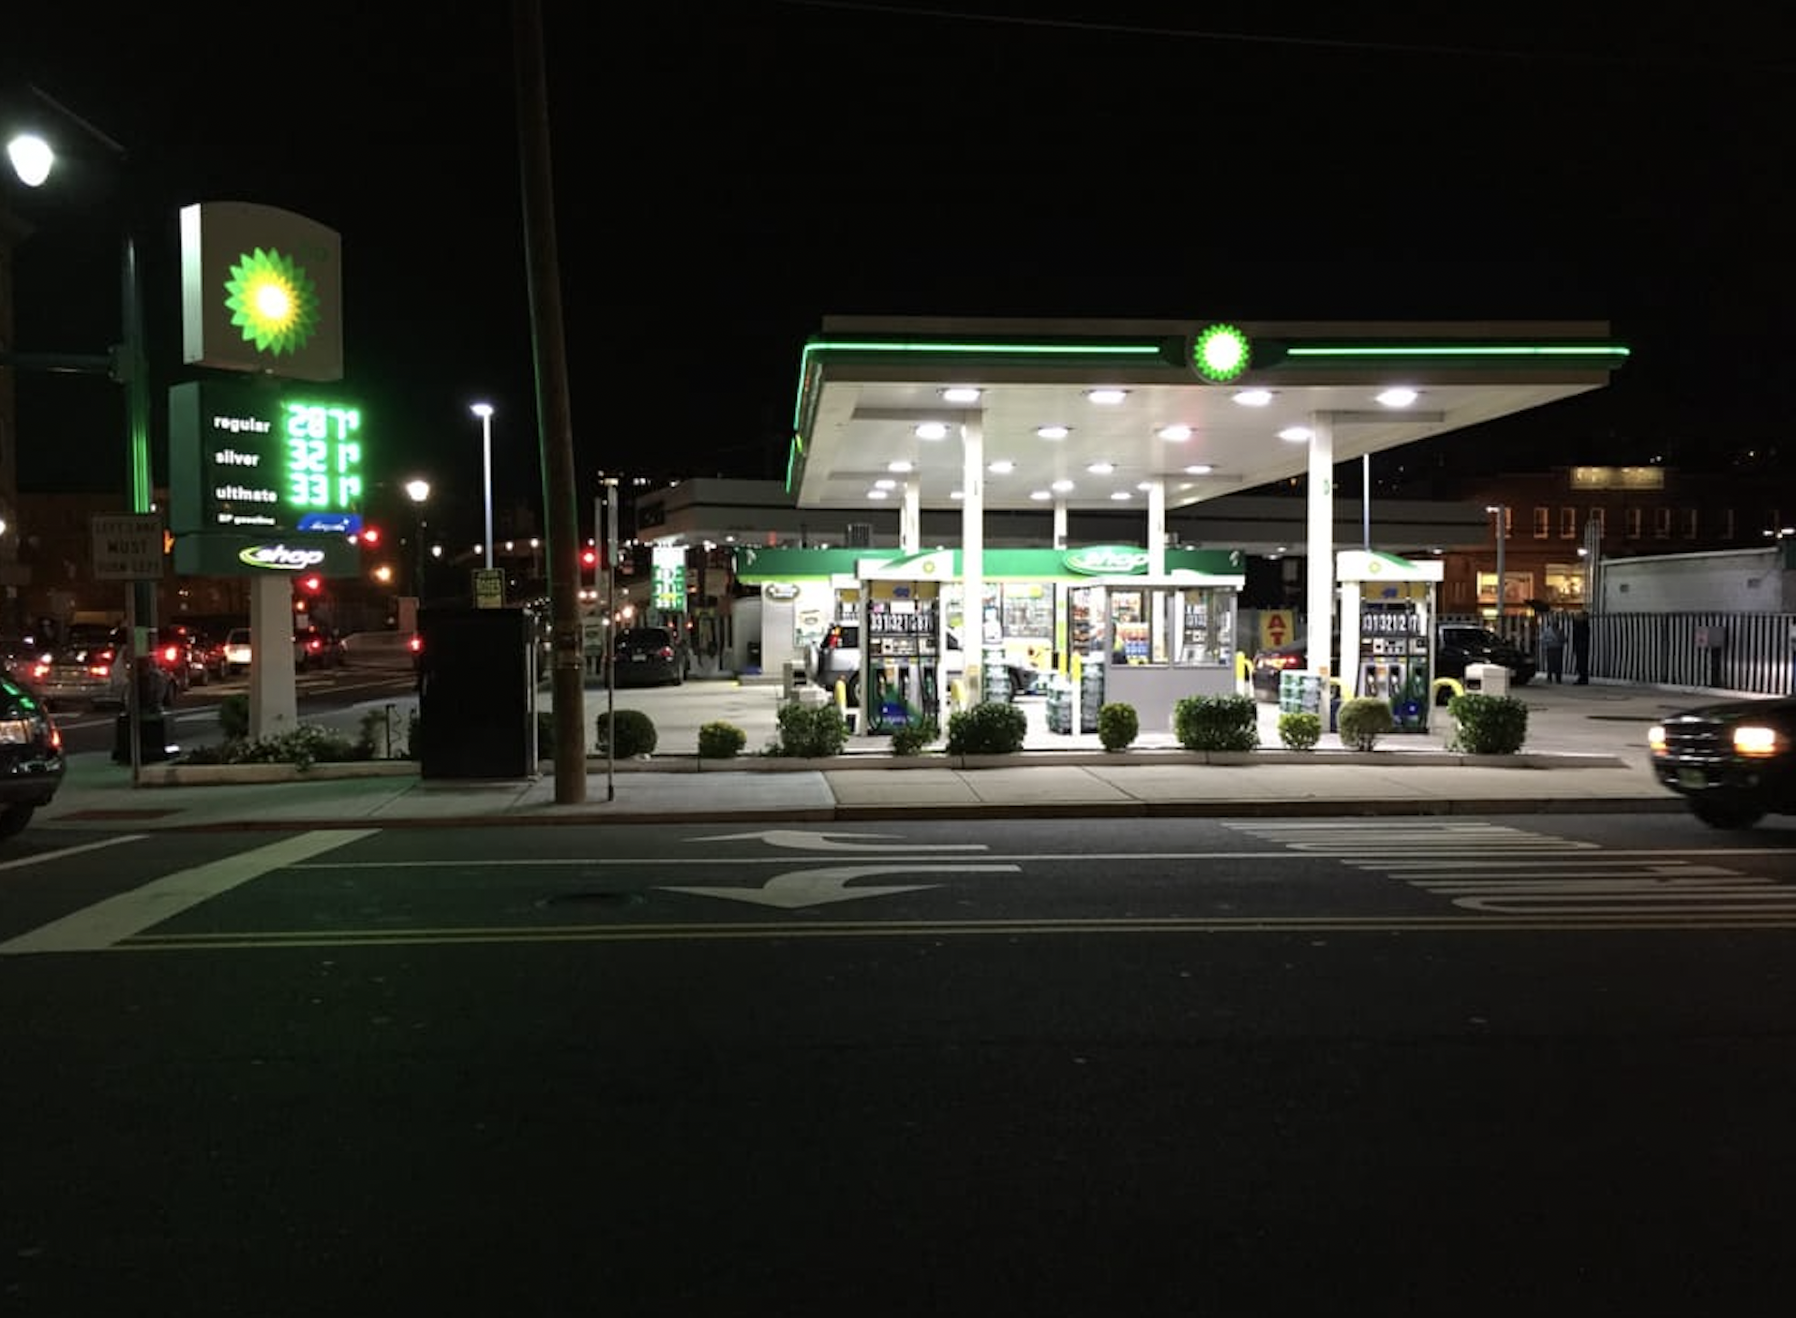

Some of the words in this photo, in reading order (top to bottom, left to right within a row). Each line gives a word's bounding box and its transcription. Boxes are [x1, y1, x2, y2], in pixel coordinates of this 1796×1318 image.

[213, 416, 271, 433] regular
[215, 449, 260, 467] silver
[215, 485, 278, 503] ultimate
[107, 540, 147, 554] MUST
[255, 544, 325, 569] shop
